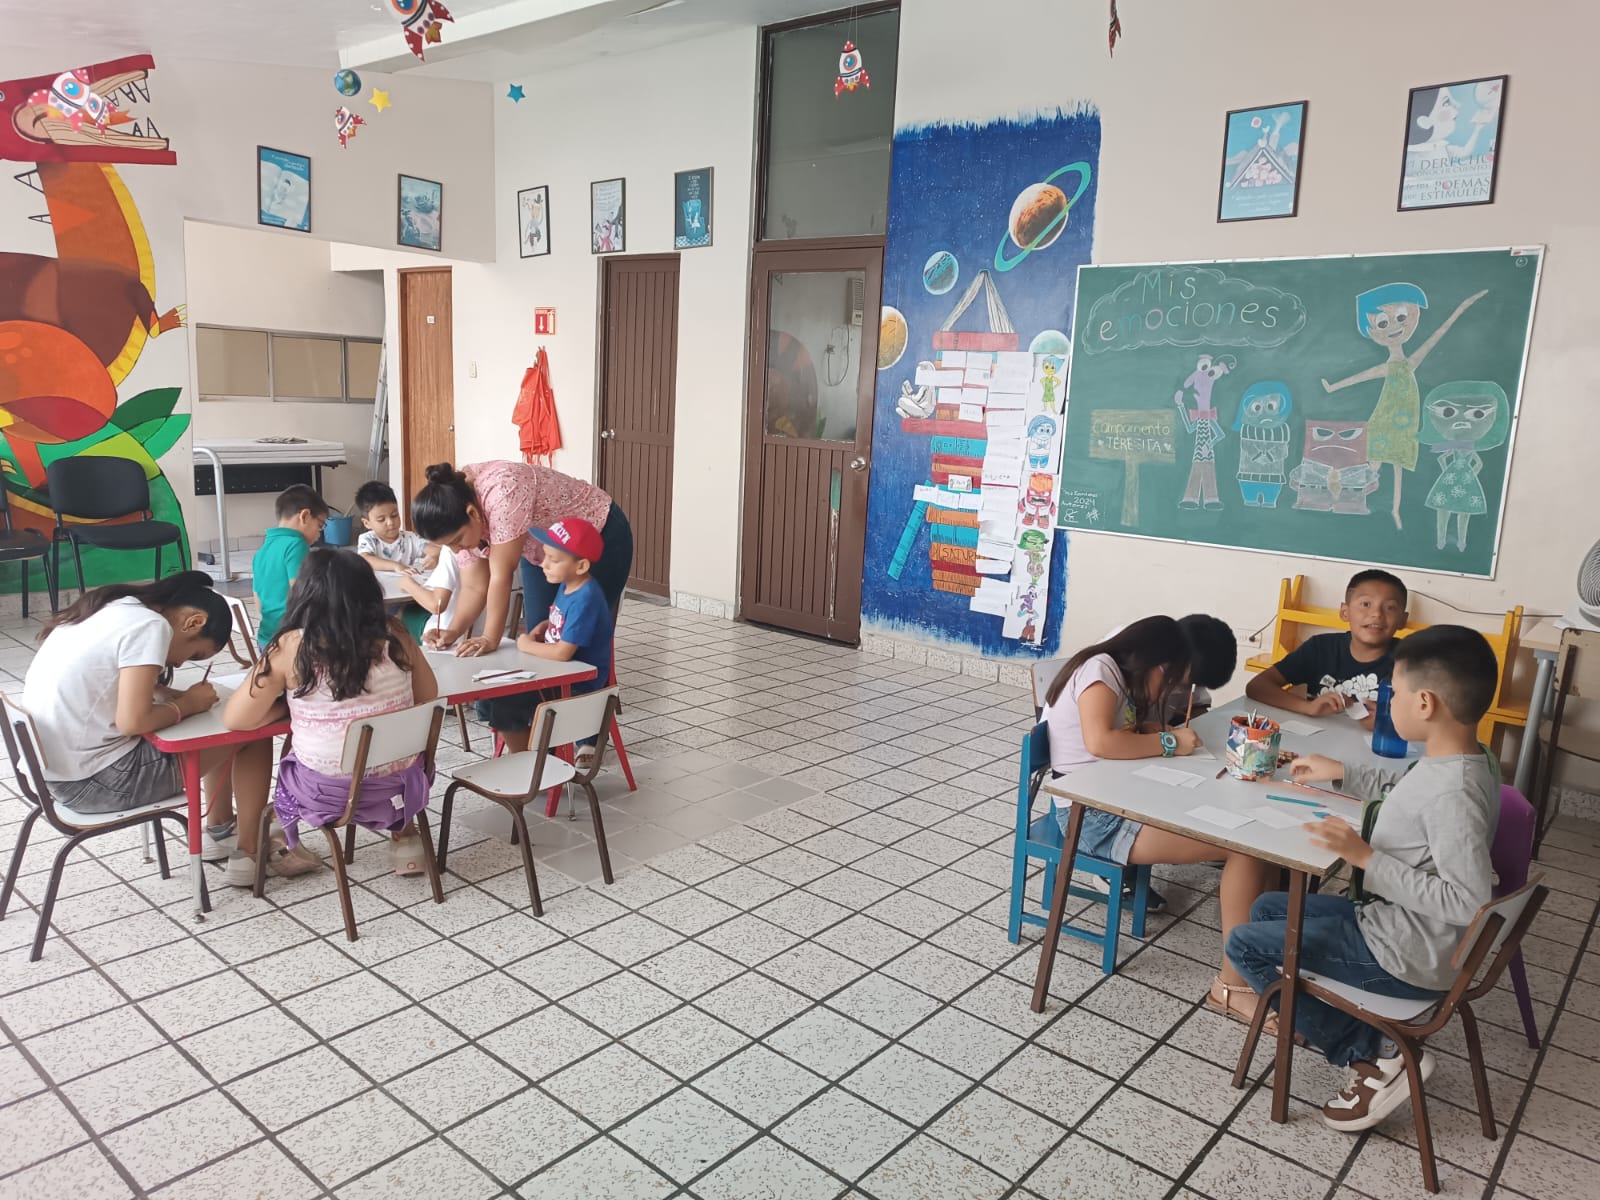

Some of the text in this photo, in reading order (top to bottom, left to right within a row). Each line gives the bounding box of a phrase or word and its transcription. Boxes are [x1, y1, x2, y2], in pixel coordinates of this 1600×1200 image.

[1434, 176, 1490, 190] POEMAS
[1420, 186, 1489, 201] ESTIMULEN
[1142, 273, 1196, 304] Mis
[1099, 301, 1280, 341] emociones
[1092, 419, 1170, 437] Campamento
[1105, 435, 1162, 454] TERESITA
[1073, 496, 1096, 507] 2024
